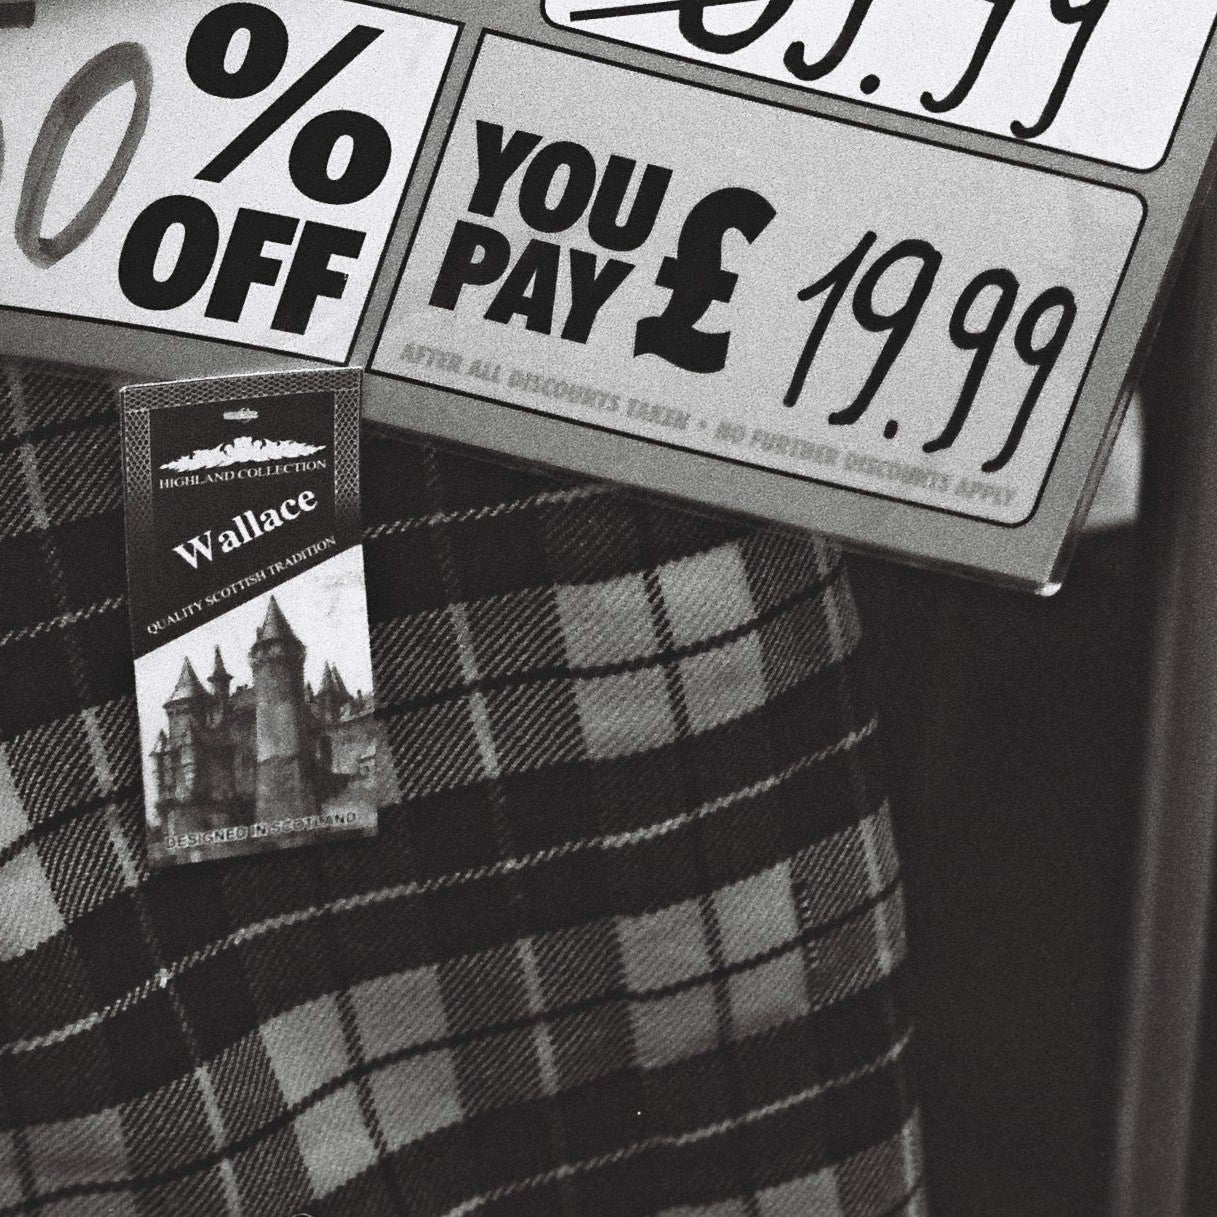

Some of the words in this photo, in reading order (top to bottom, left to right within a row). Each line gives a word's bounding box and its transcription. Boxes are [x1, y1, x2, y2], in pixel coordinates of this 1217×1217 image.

[467, 120, 673, 252] YOU
[117, 194, 367, 335] OFF
[428, 220, 636, 345] PAY
[158, 470, 235, 489] HIGHLAND
[237, 459, 328, 480] COLLECTION
[398, 341, 464, 374] AFTER
[467, 358, 502, 383] ALL
[507, 368, 622, 413] DISCOUNTS
[626, 396, 692, 430] TAKEN
[713, 420, 747, 444] NO
[749, 428, 841, 467] FURTHER
[843, 450, 952, 493] DISCOUNTS
[954, 476, 1019, 507] APPLY
[146, 600, 203, 635] QUALITY
[205, 569, 268, 606] SCOTTISH
[267, 535, 337, 577] TRADITION
[172, 490, 318, 570] Wallace
[165, 824, 249, 849] DESIGNED
[250, 820, 269, 838] IN
[270, 811, 358, 834] SCOTLAND
